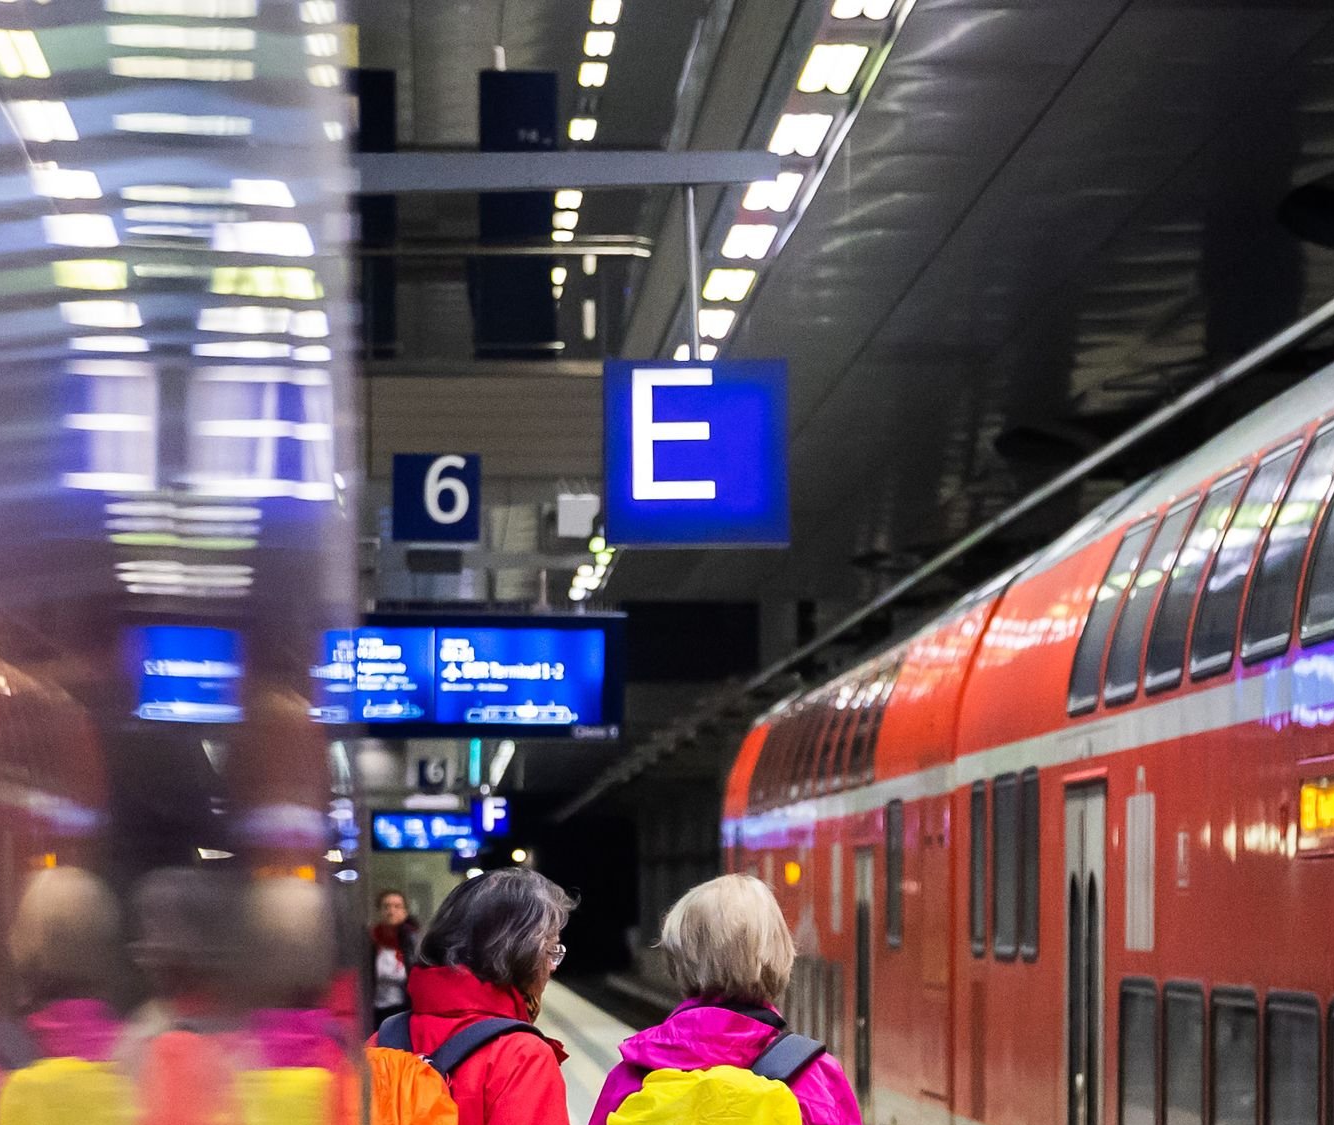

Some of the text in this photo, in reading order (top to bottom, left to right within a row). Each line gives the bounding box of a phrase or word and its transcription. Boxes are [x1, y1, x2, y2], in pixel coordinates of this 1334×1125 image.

[632, 368, 716, 500] E
[424, 455, 469, 524] 6
[426, 761, 444, 784] 6
[482, 796, 507, 832] F
